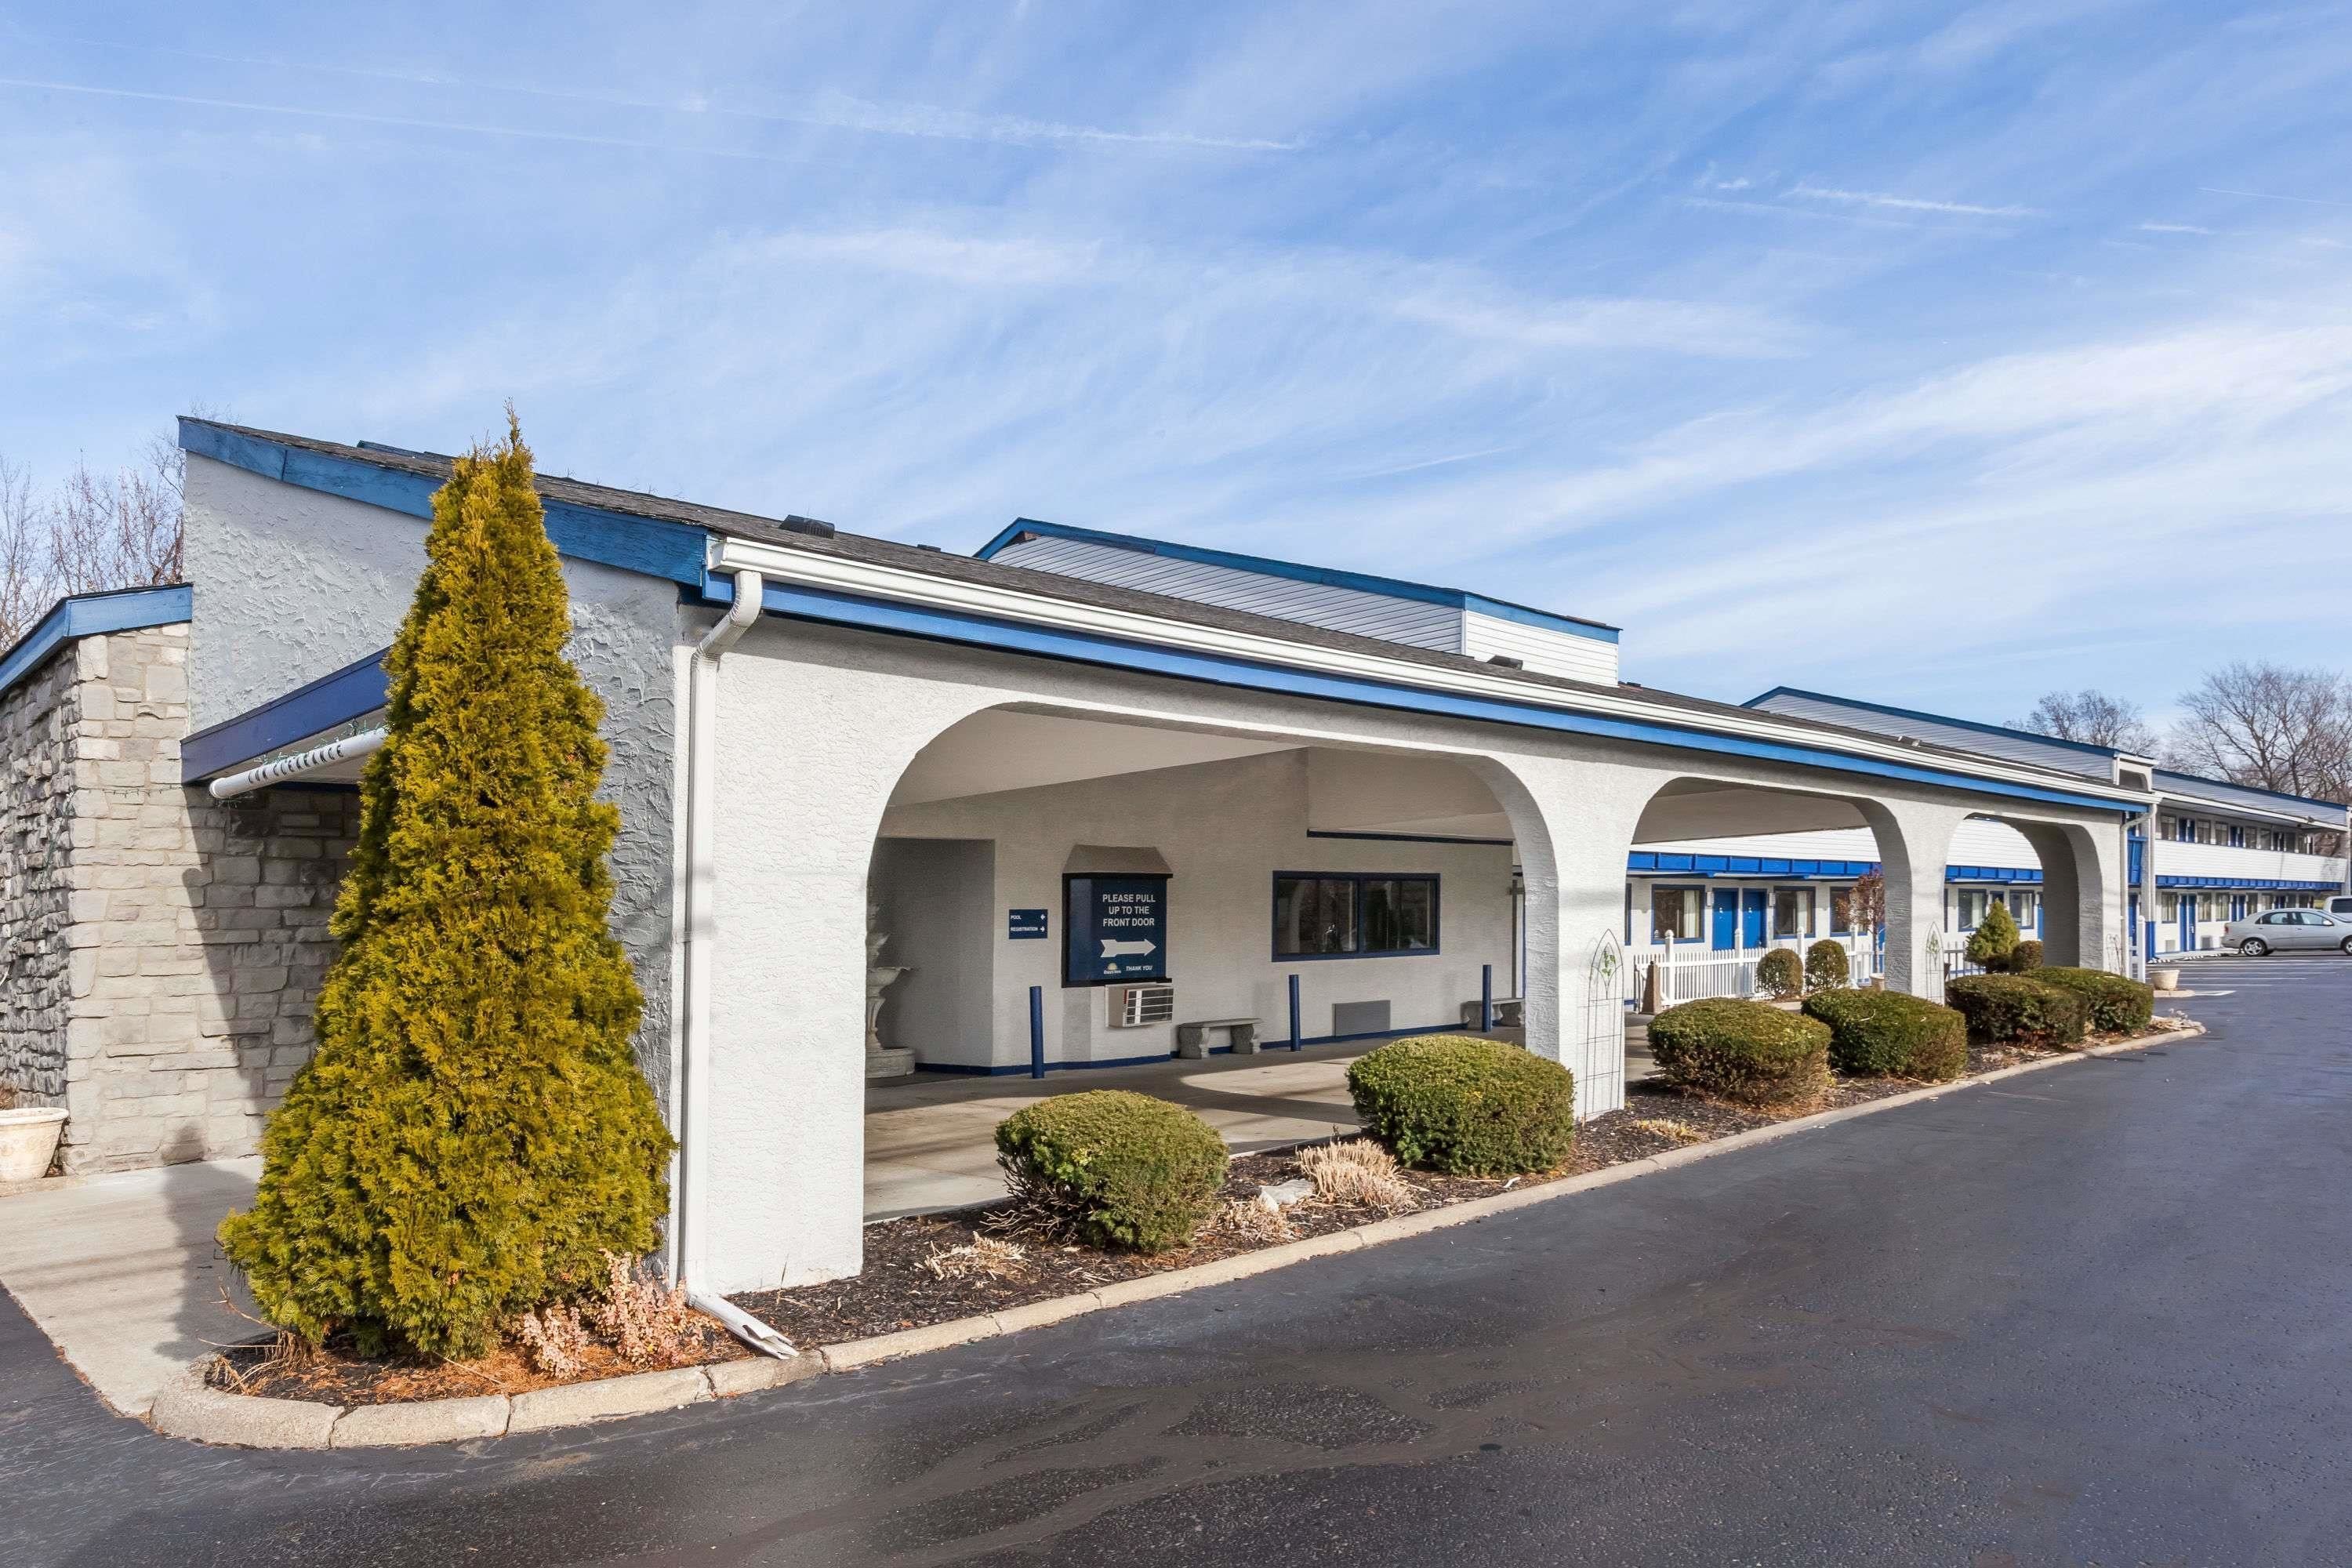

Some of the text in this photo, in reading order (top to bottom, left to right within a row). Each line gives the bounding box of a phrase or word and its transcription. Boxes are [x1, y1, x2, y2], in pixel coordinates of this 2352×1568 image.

[1102, 894, 1156, 902] PLEASE PULL
[1109, 906, 1149, 914] UP TO THE
[1103, 918, 1155, 927] FRONT DOOR
